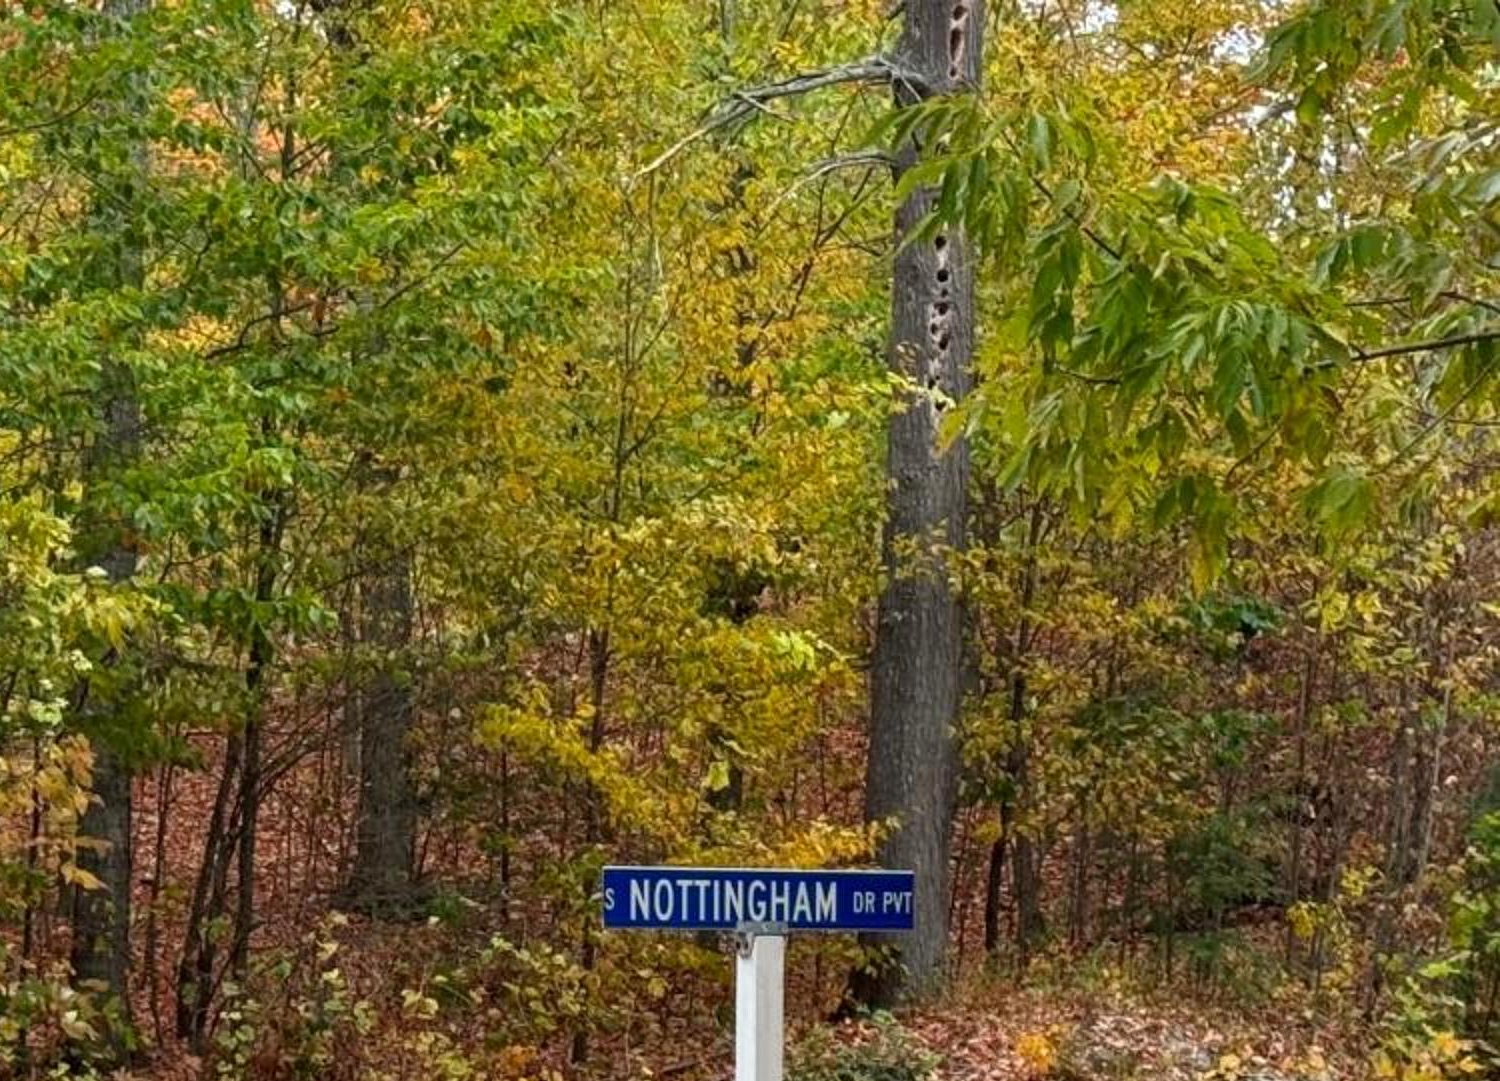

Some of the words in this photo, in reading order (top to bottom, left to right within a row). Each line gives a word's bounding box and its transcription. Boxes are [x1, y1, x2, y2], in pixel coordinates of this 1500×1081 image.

[604, 887, 615, 911] S
[630, 878, 838, 923] NOTTINGHAM
[853, 891, 876, 914] DR
[882, 891, 913, 914] PVT
